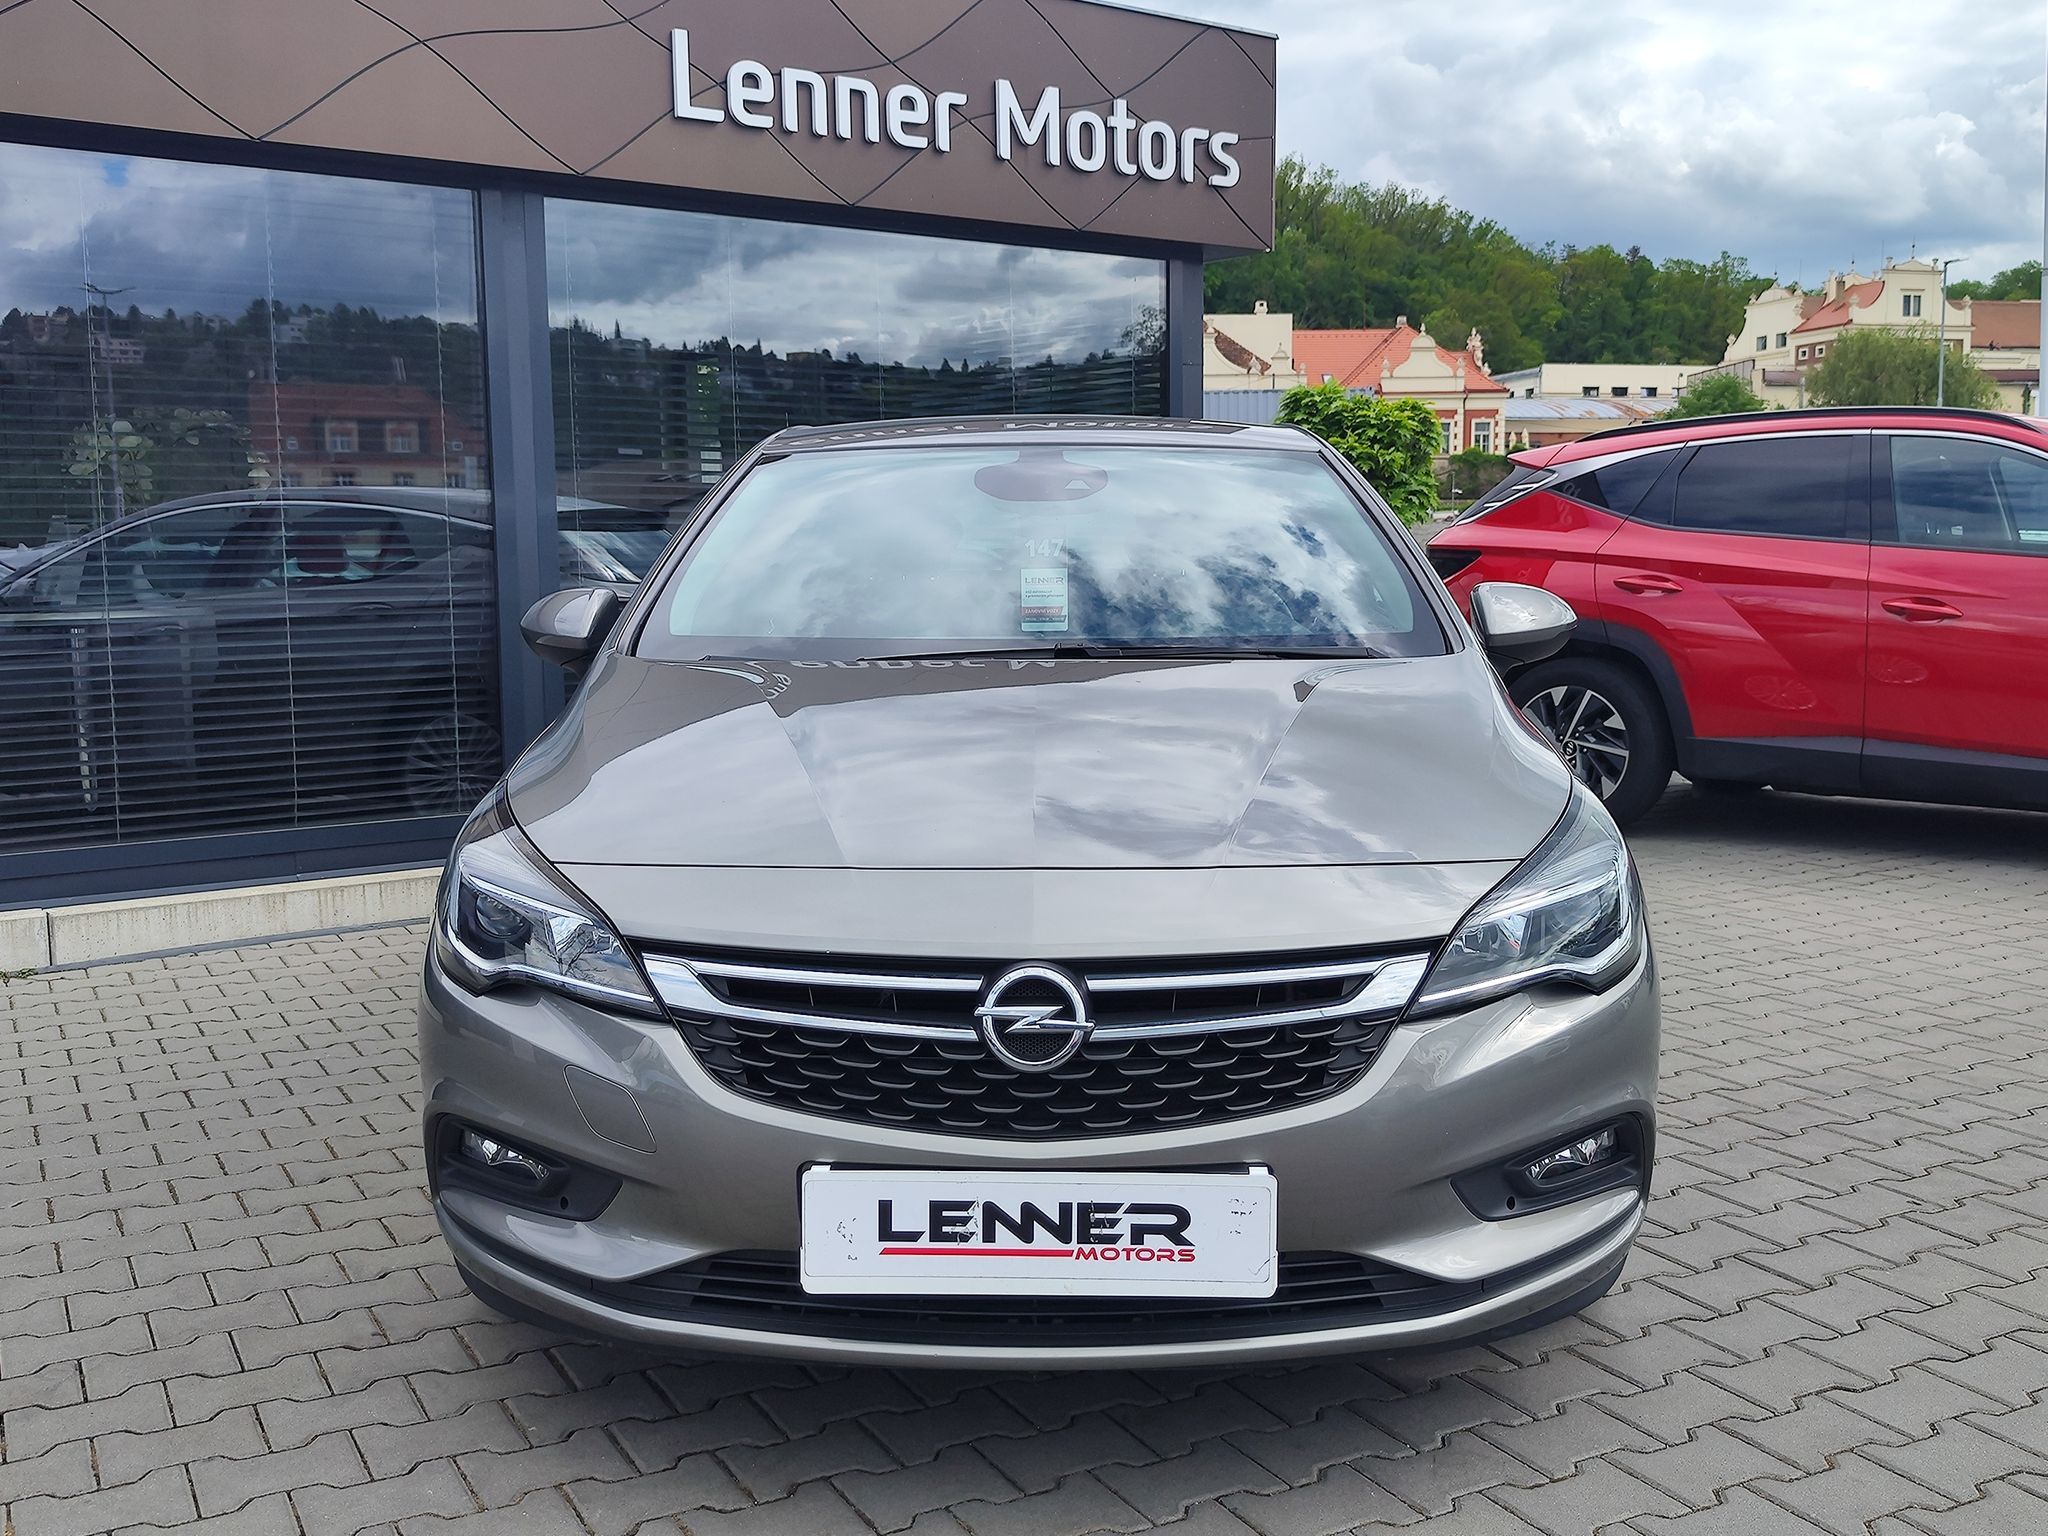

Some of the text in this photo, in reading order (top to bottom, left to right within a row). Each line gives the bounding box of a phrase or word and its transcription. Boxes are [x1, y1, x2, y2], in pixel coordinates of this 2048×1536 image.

[671, 28, 1241, 189] Lenner Motors
[1024, 538, 1064, 558] 147
[1024, 576, 1064, 585] LENNER
[878, 1199, 1195, 1247] LENNER
[1075, 1246, 1196, 1263] MOTORS
